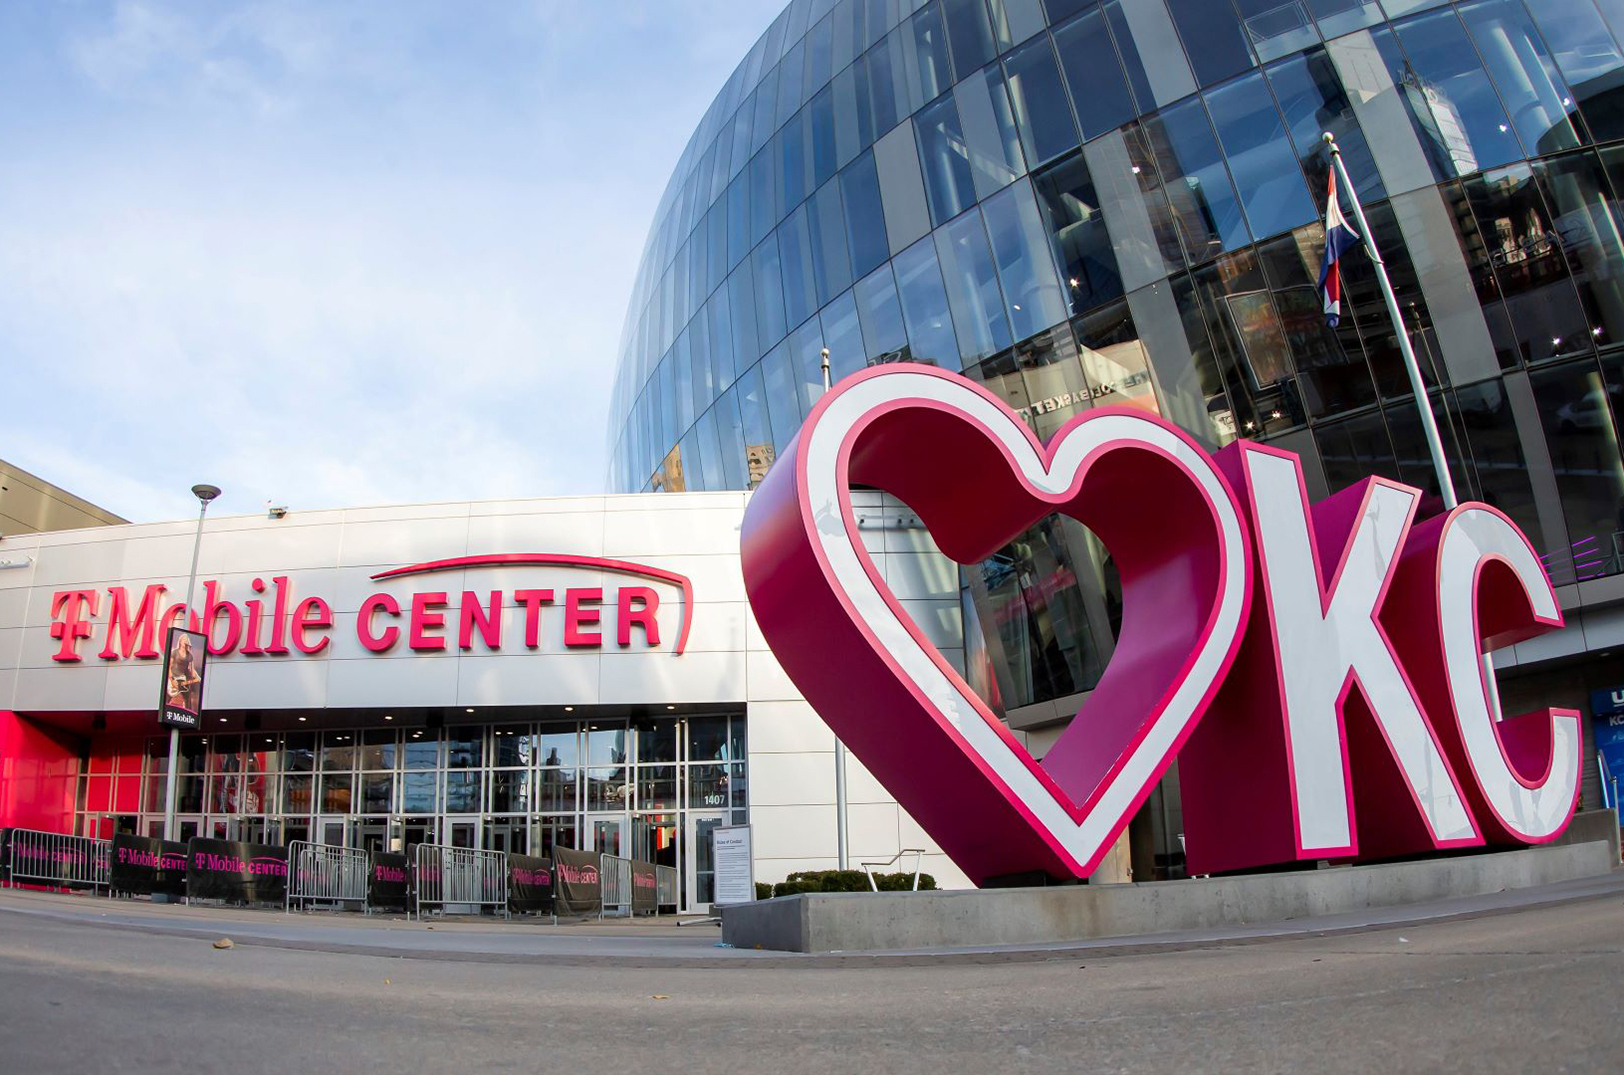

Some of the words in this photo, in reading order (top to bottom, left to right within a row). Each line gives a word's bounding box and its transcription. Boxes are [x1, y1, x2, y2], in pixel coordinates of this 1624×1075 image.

[356, 586, 661, 653] CENTER
[1236, 438, 1583, 862] KC
[173, 713, 195, 724] Mobile
[704, 794, 725, 805] 1407
[127, 849, 158, 867] Mobile
[160, 857, 188, 871] CENTE
[207, 854, 245, 873] Mobile
[247, 862, 288, 876] CENTER
